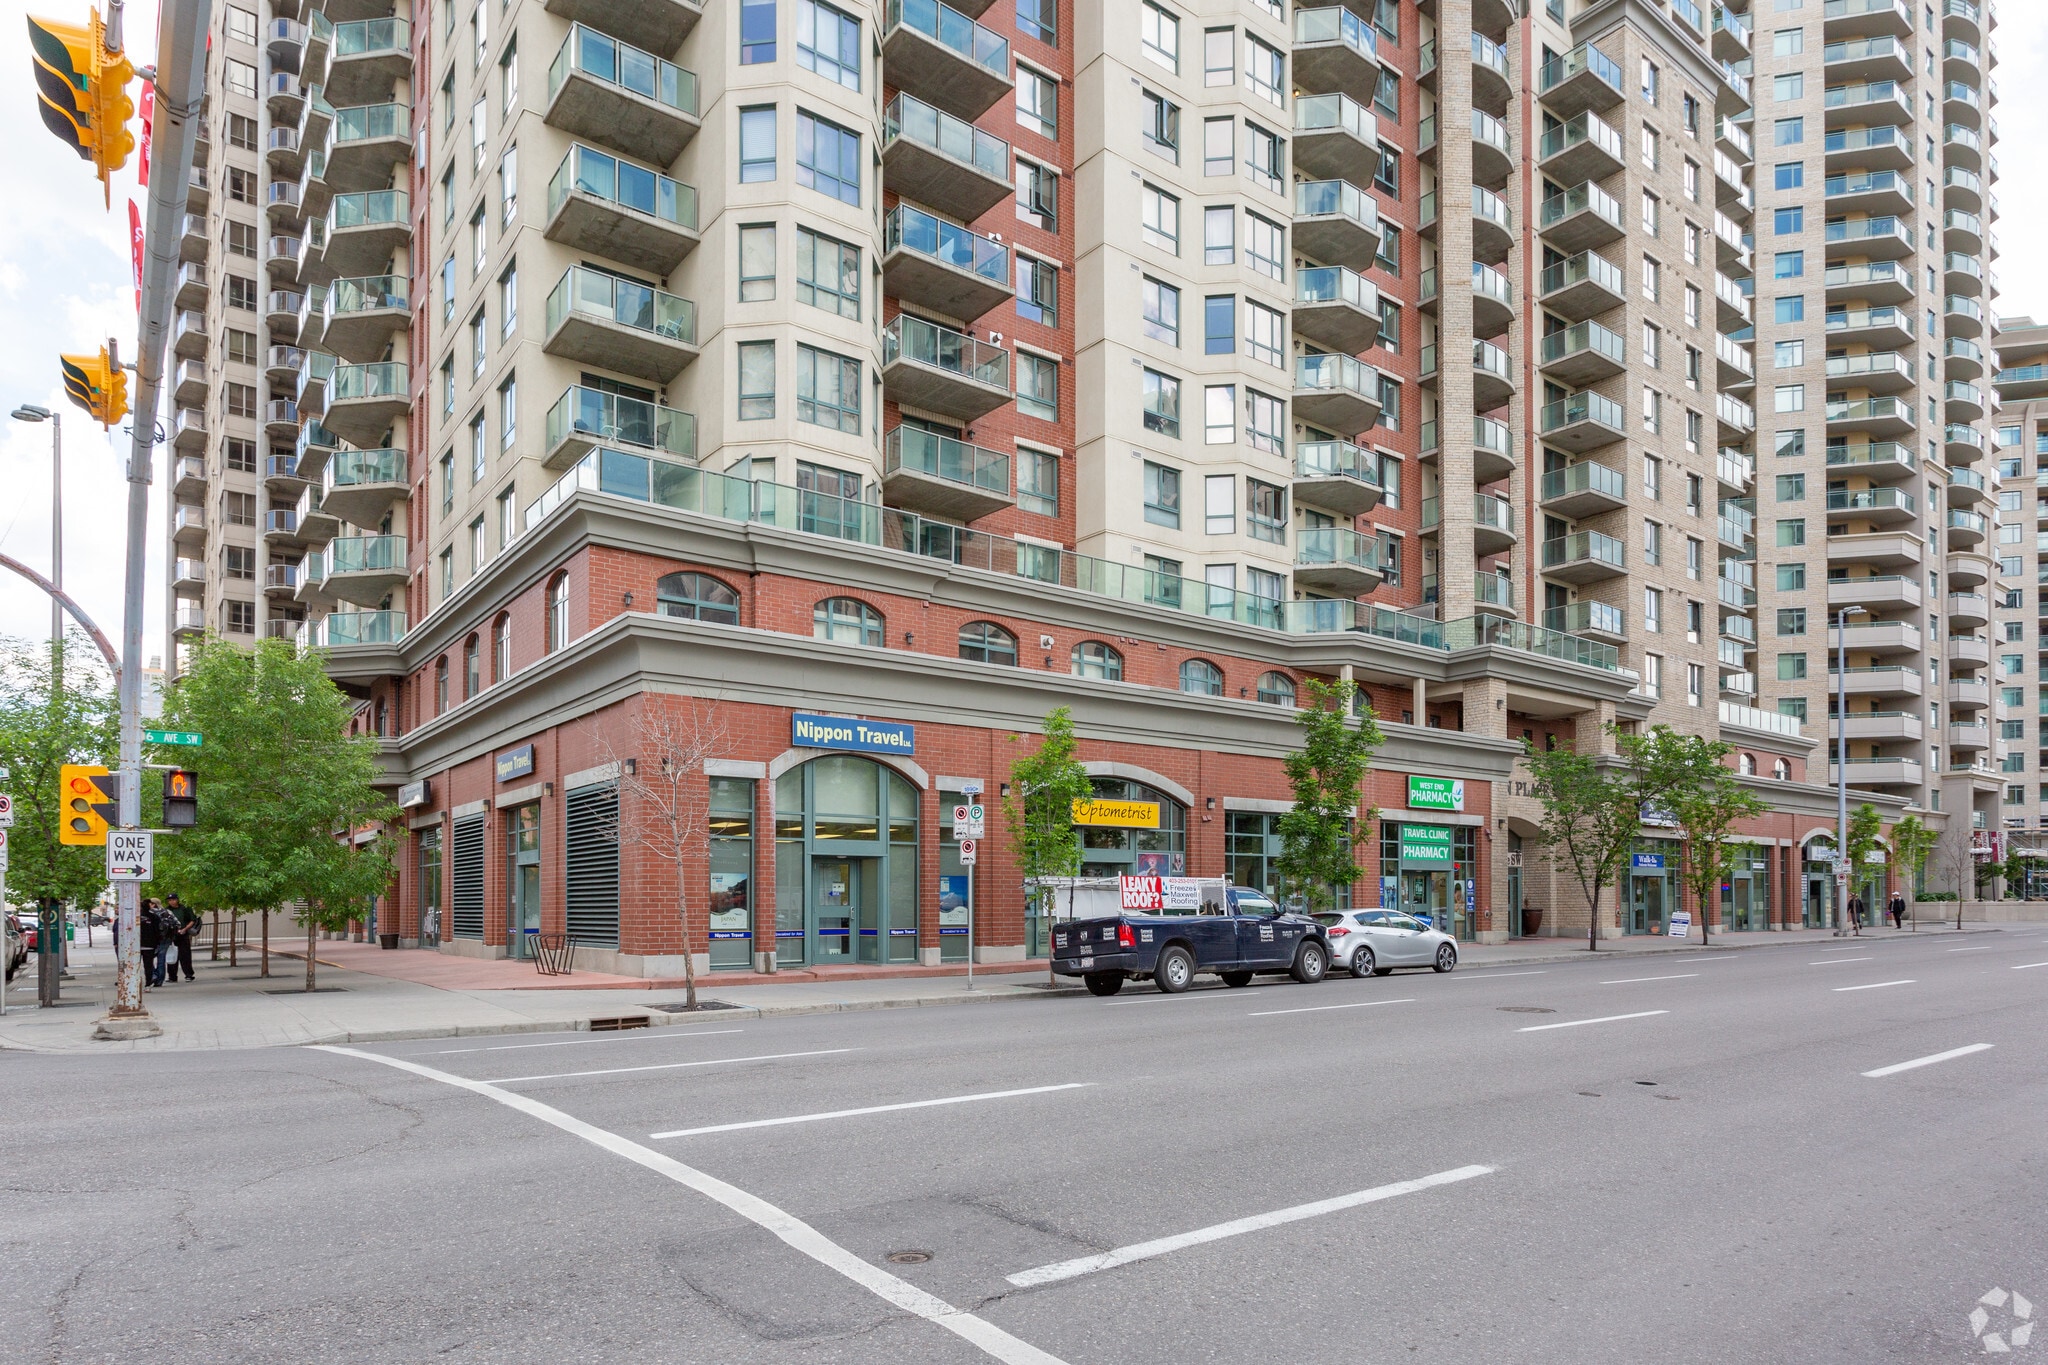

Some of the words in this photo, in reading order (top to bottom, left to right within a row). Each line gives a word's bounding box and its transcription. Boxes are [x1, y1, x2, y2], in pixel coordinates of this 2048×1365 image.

[164, 733, 178, 743] AVE
[186, 734, 198, 744] SW
[796, 720, 852, 743] Nippon
[857, 726, 904, 746] Travel
[497, 760, 513, 776] Nippon
[513, 752, 529, 770] Travel
[1419, 782, 1433, 790] WEST
[1411, 790, 1452, 803] PHARMACY
[1079, 799, 1152, 823] Optometrist
[1403, 828, 1428, 838] TRAVEL
[1428, 830, 1449, 840] CLINIC
[115, 836, 146, 849] ONE
[114, 850, 146, 862] WAY
[1403, 846, 1449, 859] PHARMACY
[1511, 854, 1522, 865] SW
[1121, 876, 1157, 892] LEAKY
[1123, 892, 1160, 907] ROOF?
